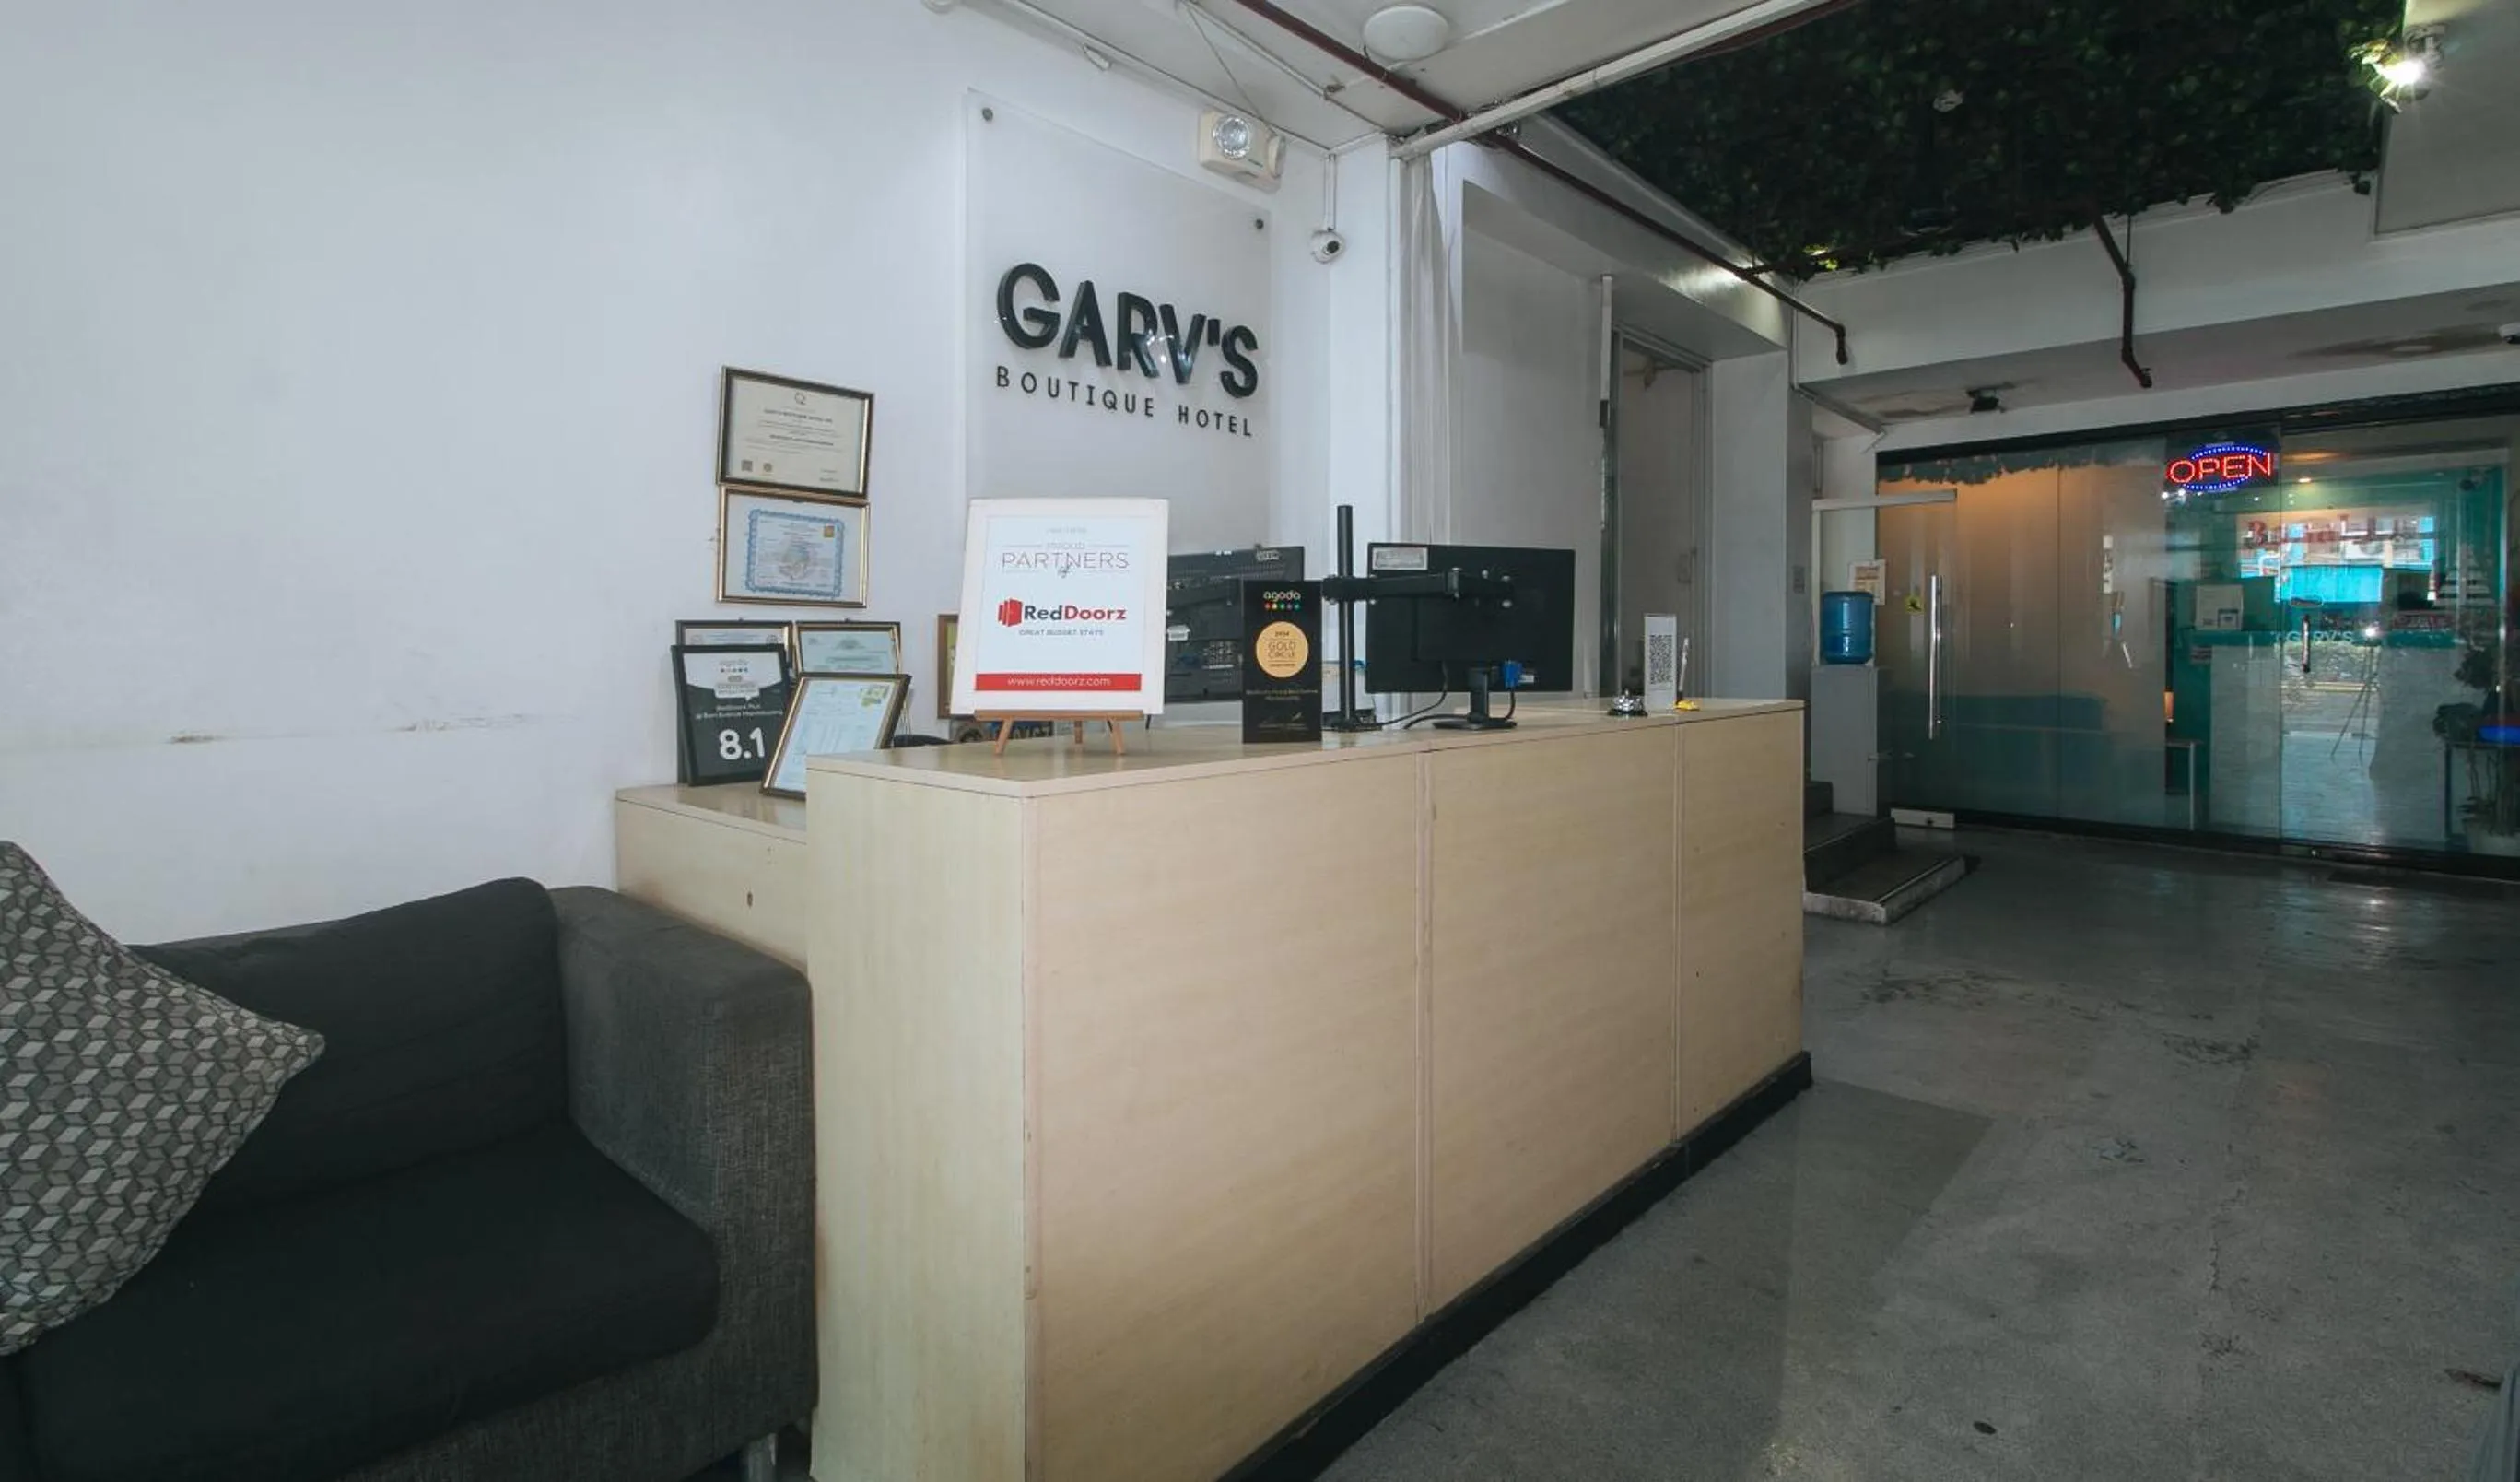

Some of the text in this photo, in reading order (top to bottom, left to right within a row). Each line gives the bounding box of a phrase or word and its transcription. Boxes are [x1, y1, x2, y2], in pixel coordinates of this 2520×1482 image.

[996, 263, 1259, 399] GARV'S
[996, 365, 1252, 438] BOUTIQUE HOTEL
[2165, 452, 2274, 485] OPEN
[1002, 552, 1131, 569] PARTNERS
[1263, 590, 1301, 602] agoda
[1024, 604, 1127, 621] RedDoorz
[2286, 630, 2354, 643] GRV'S
[1268, 641, 1296, 651] GOLD
[1007, 676, 1111, 687] www.reddoorz.com
[719, 727, 765, 760] 8.1
